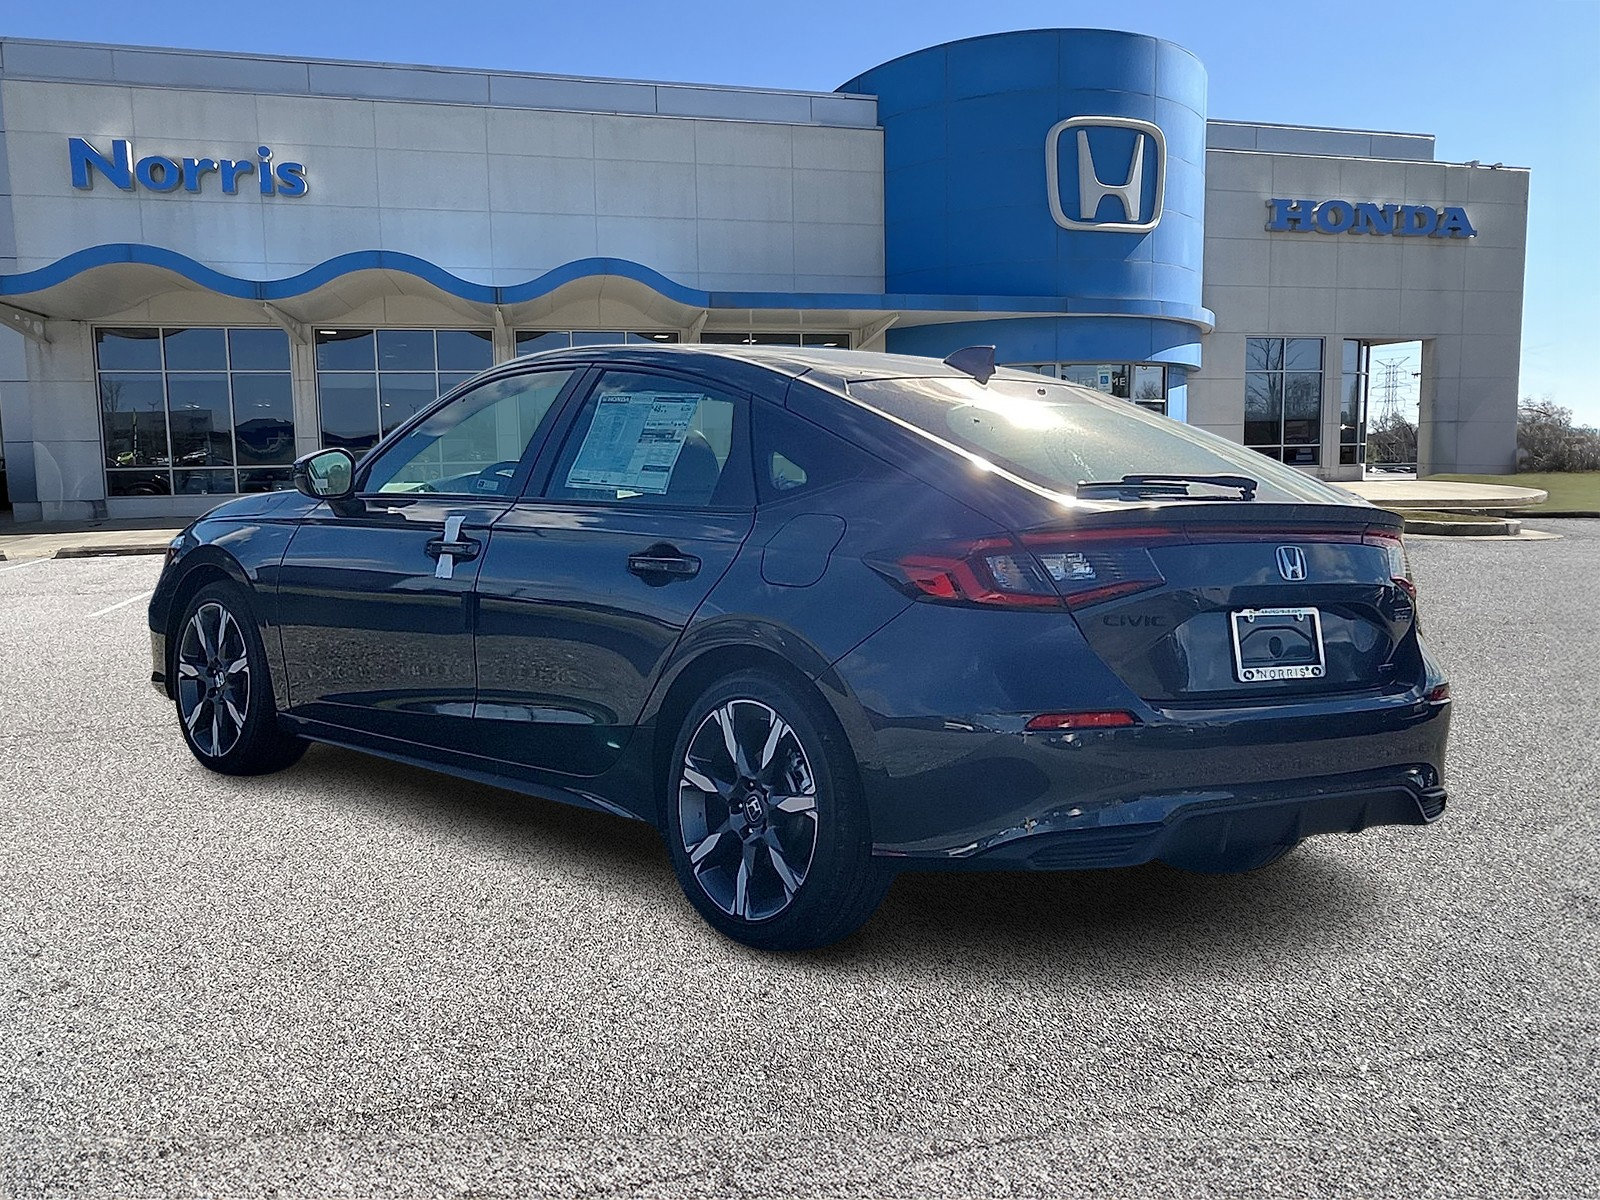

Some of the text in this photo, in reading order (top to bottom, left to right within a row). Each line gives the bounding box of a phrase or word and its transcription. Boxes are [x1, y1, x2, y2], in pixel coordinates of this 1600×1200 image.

[67, 137, 308, 197] Norris
[1264, 198, 1478, 240] HONDA
[1102, 614, 1167, 627] CIVIC
[1259, 667, 1306, 679] NORRIS
